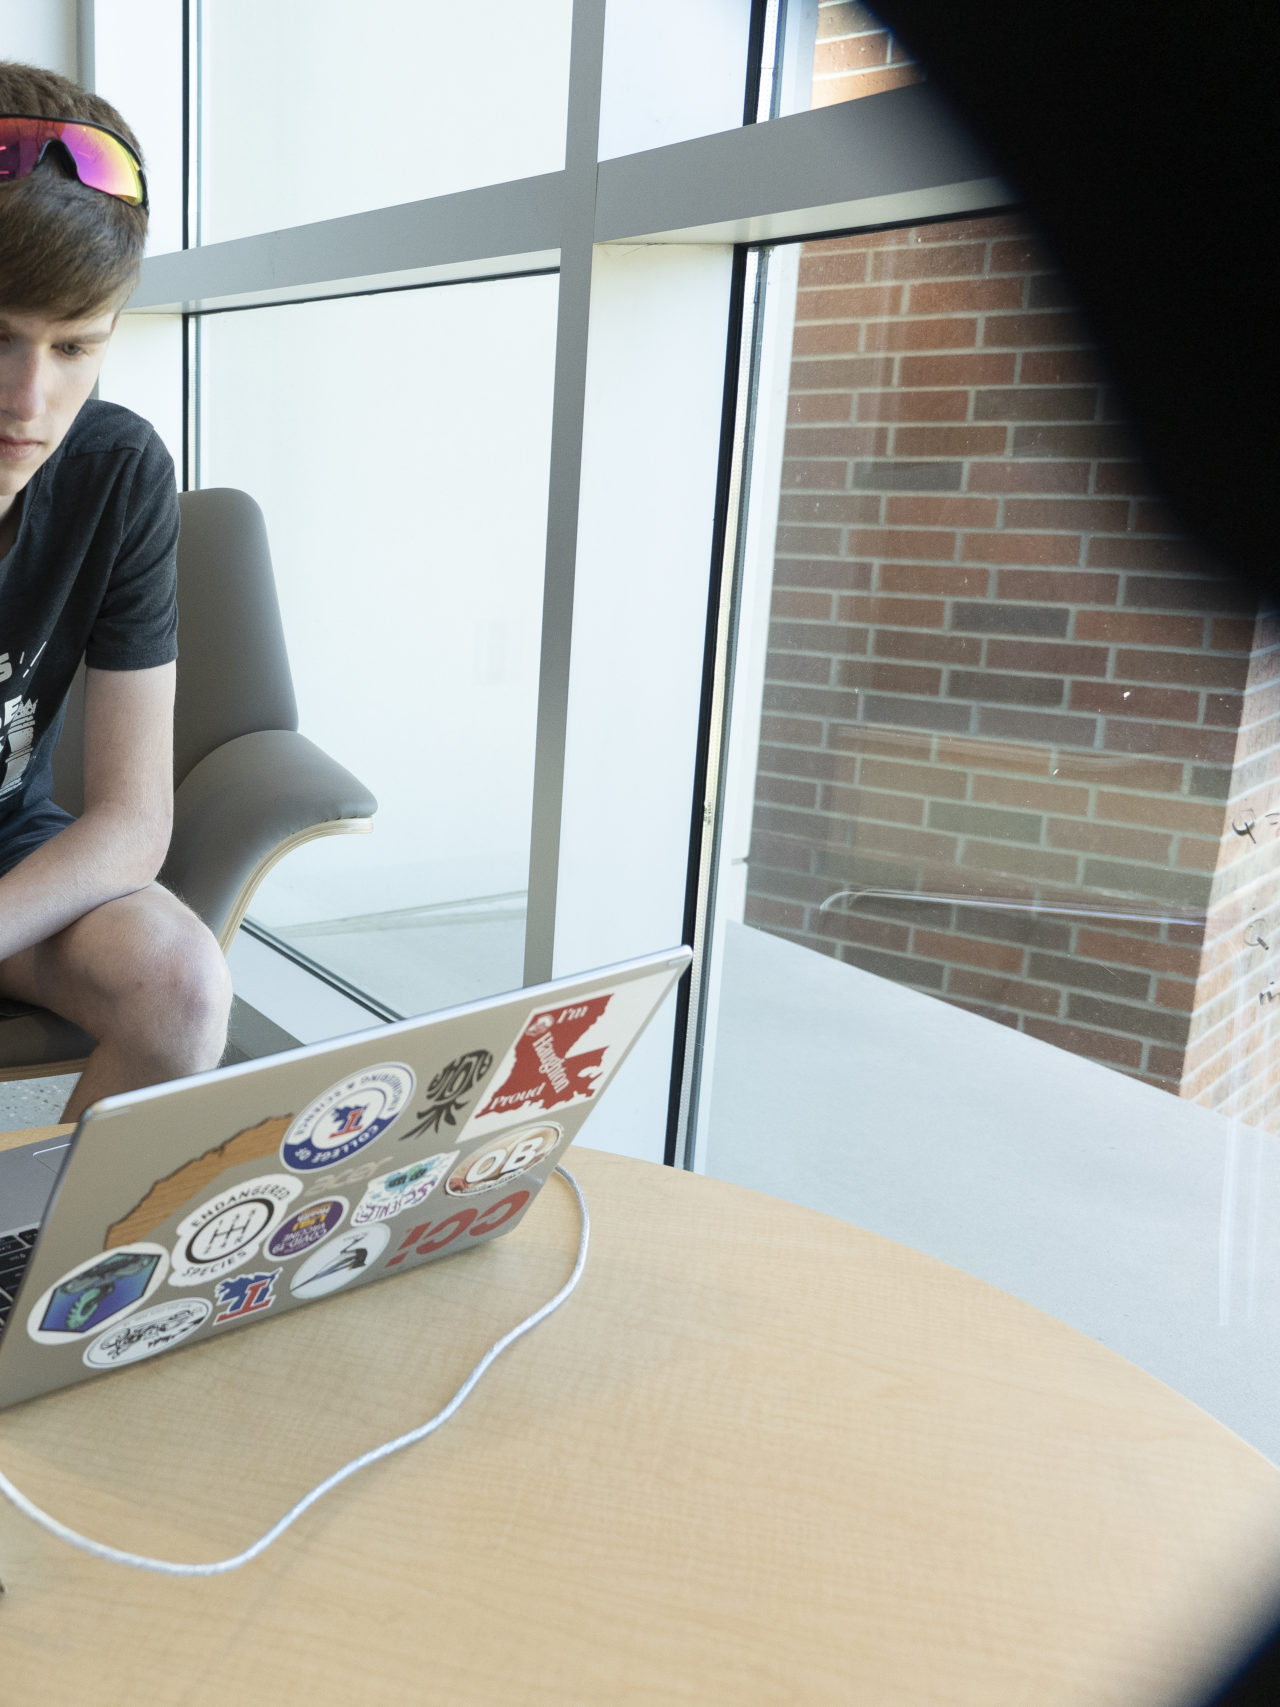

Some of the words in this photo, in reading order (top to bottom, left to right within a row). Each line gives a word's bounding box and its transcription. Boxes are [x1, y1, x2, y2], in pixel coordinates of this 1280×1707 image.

[556, 1005, 589, 1025] I'm
[532, 1032, 571, 1094] Haughton
[489, 1081, 546, 1111] Proud
[311, 1124, 380, 1164] COLLEGE
[302, 1156, 394, 1198] acer
[190, 1183, 292, 1228] ENDANGERED
[181, 1251, 247, 1278] SPECIES
